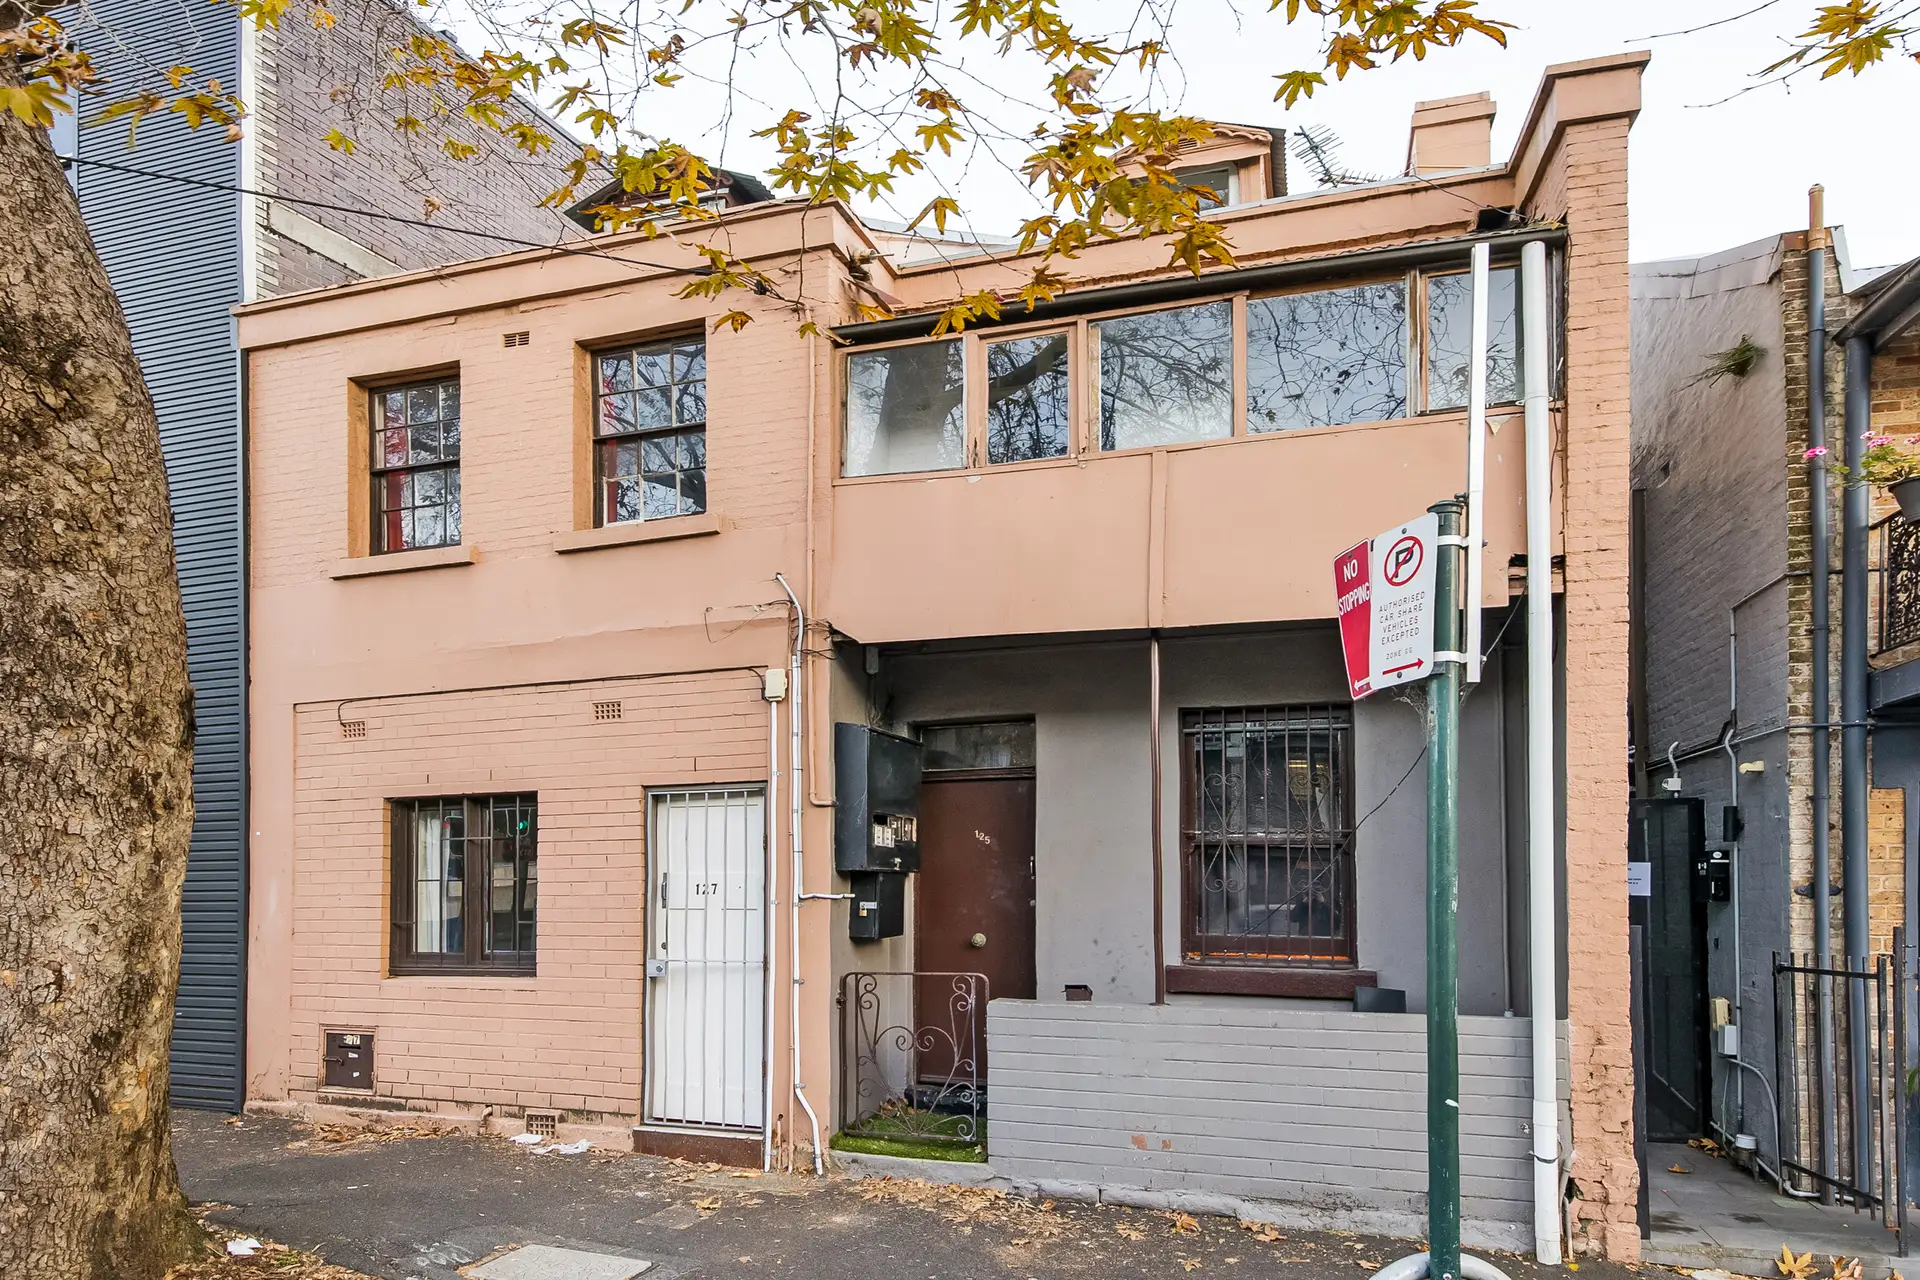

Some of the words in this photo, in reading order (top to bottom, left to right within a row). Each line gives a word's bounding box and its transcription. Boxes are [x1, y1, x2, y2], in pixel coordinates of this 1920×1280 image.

[1343, 559, 1358, 583] NO
[1338, 581, 1370, 616] STOPPING
[1379, 591, 1425, 613] AUTHORISED
[1379, 612, 1394, 624] CAR
[1397, 602, 1423, 618] SHARE
[1382, 615, 1419, 633] VEHICLES
[1381, 626, 1420, 646] EXCEPTED
[1385, 649, 1402, 660] ZONE
[974, 829, 991, 845] 125
[695, 883, 718, 896] 127
